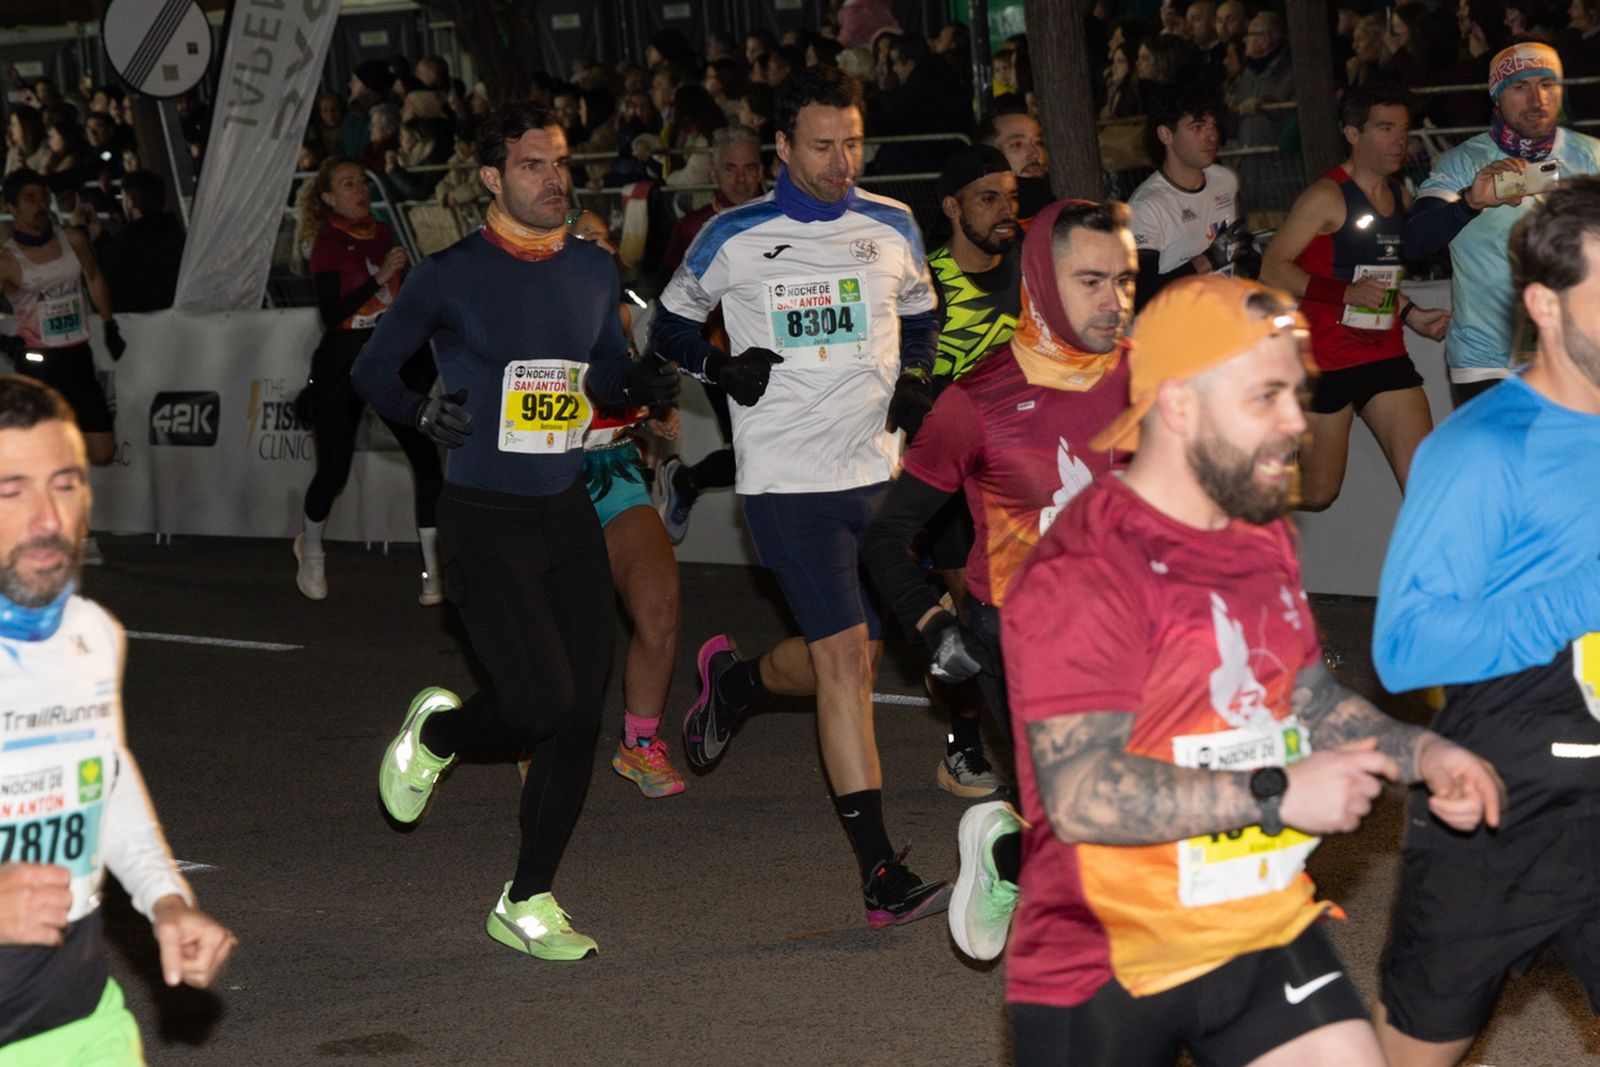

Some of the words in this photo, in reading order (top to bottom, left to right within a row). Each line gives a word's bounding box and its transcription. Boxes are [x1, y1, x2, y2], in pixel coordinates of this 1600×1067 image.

[787, 285, 817, 297] NOCHE
[819, 284, 830, 294] DE
[799, 294, 831, 307] ANTÓN
[787, 306, 854, 338] 8304
[263, 378, 285, 398] THE
[514, 381, 533, 391] SAN
[526, 370, 555, 379] NOCHE
[152, 403, 213, 434] 42K
[261, 402, 312, 431] FIS
[521, 393, 579, 421] 9522
[258, 433, 313, 461] CLINIC
[3, 702, 112, 732] TrailRunne
[1, 776, 45, 795] NOCHE
[0, 811, 85, 865] 7878
